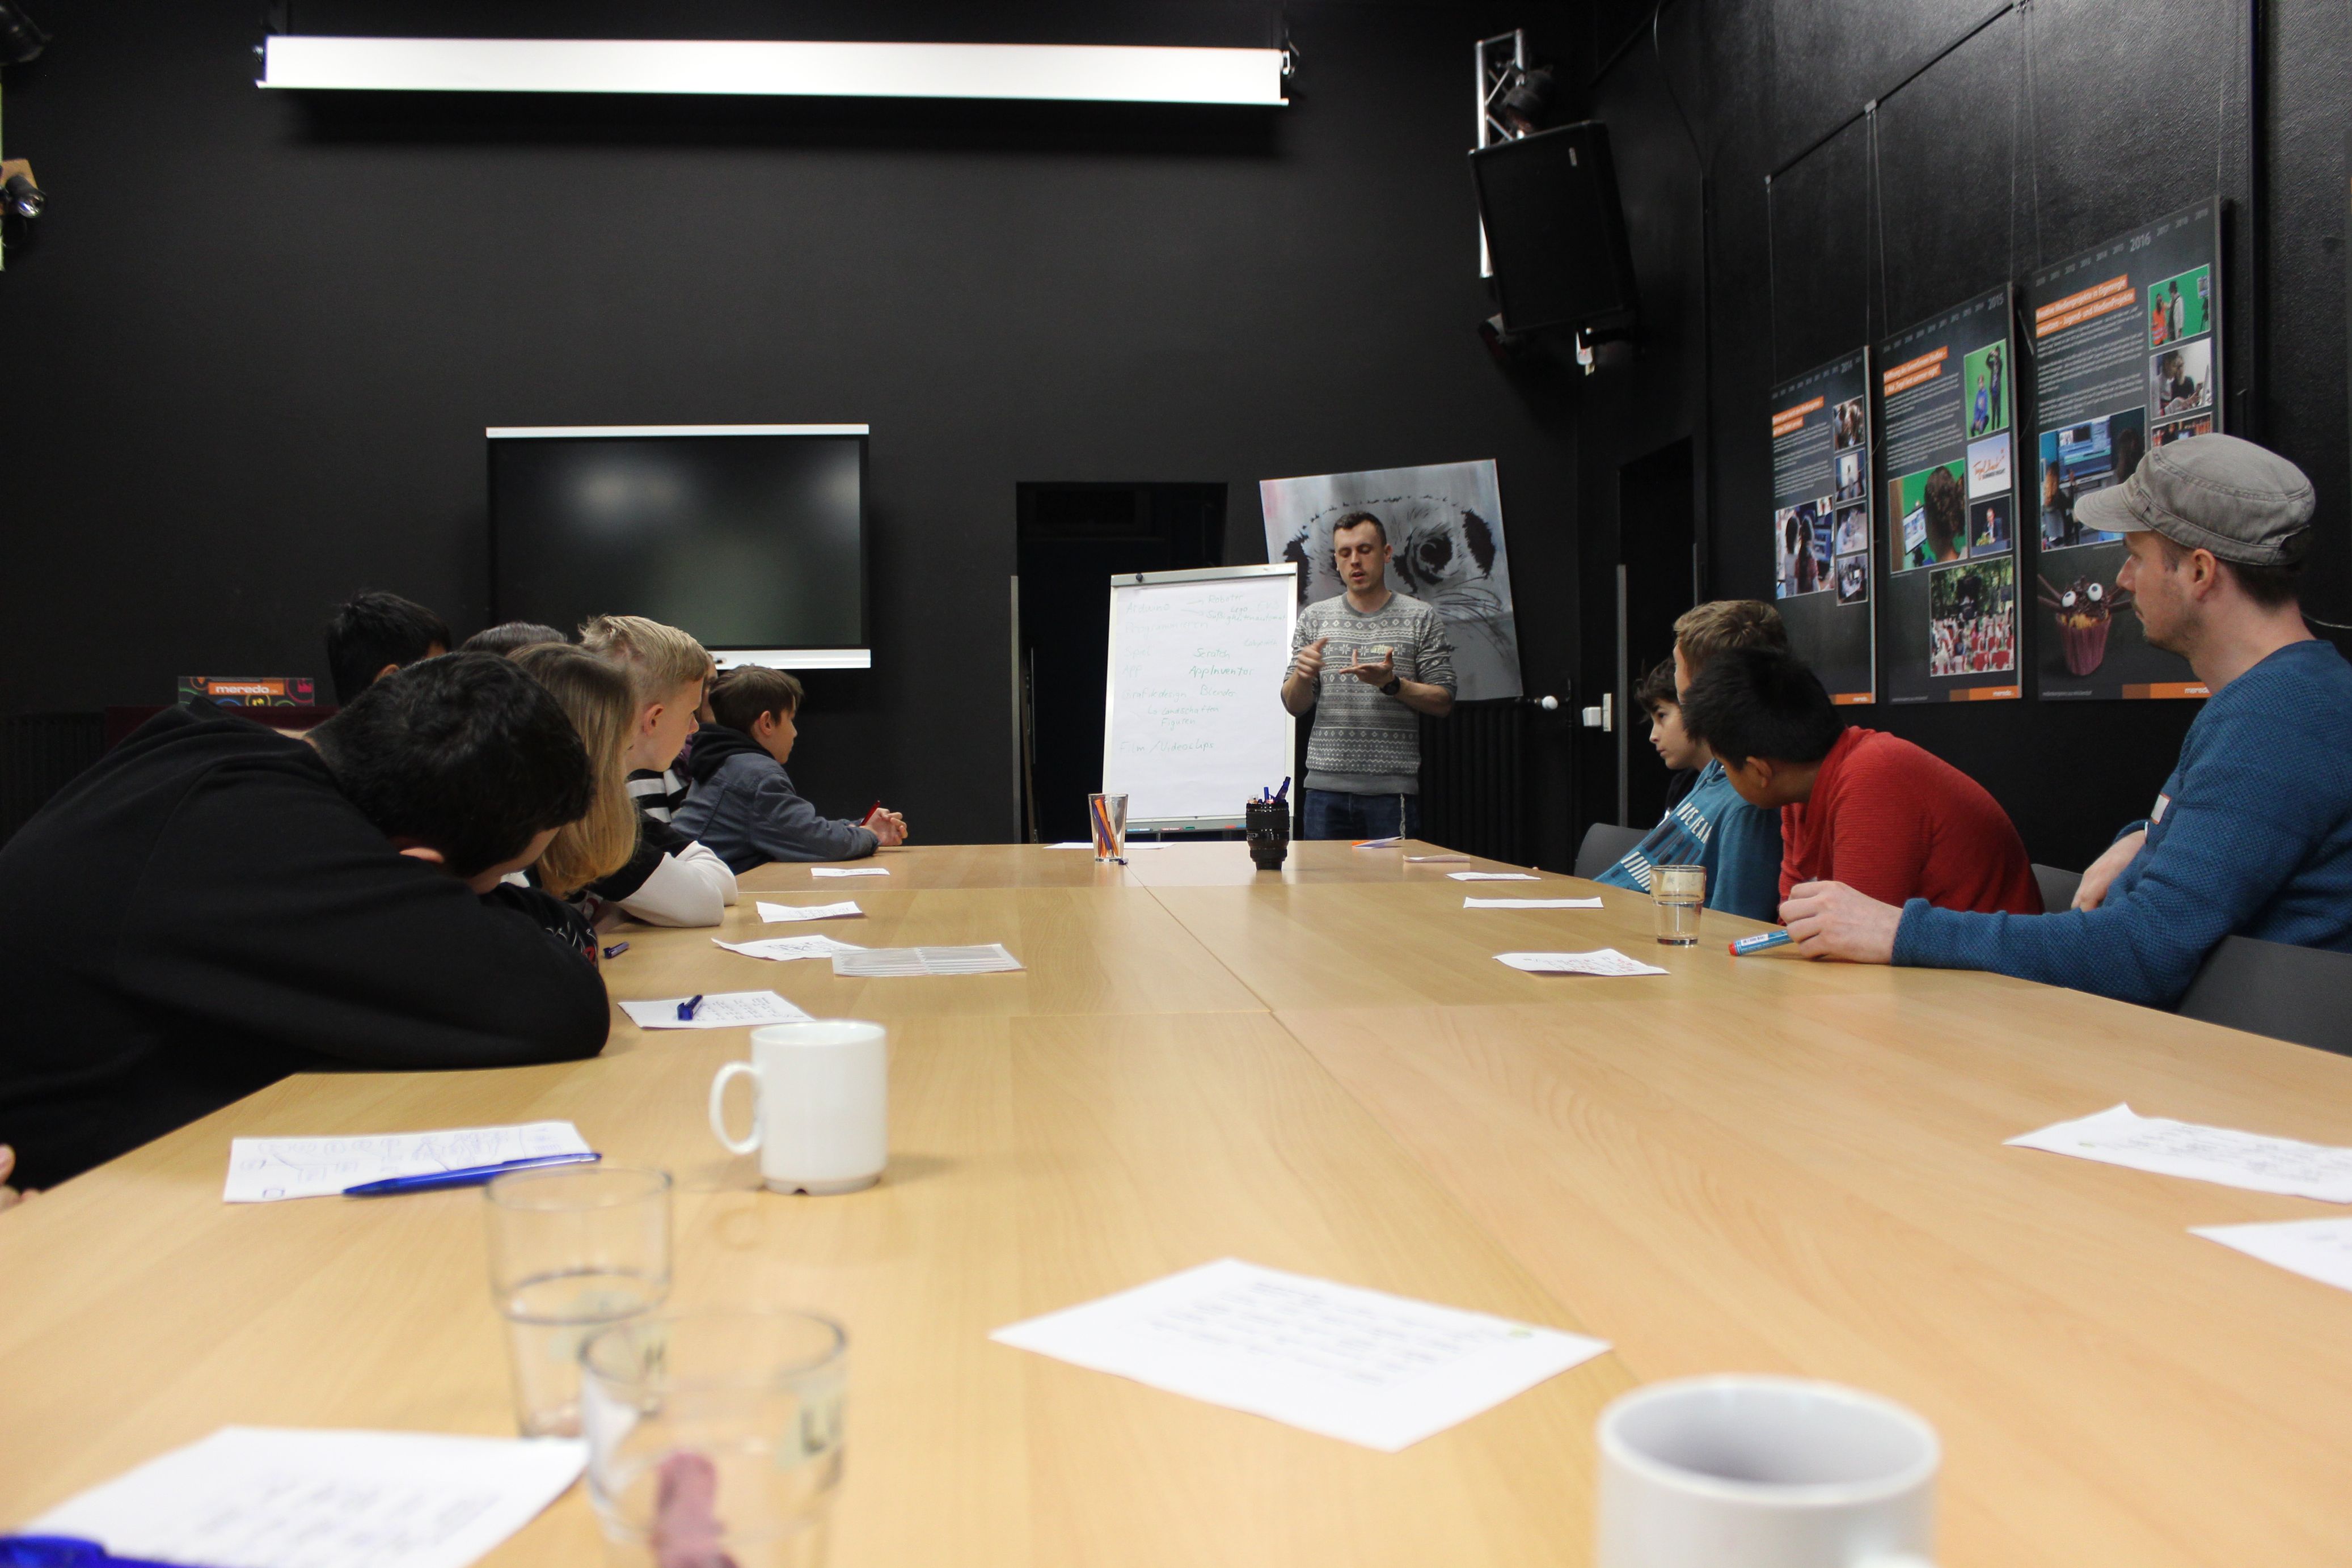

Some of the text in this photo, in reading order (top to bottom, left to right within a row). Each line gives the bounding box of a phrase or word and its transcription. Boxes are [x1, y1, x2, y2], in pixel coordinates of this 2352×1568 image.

[2130, 231, 2151, 252] 2016
[1208, 594, 1244, 604] Roboter
[1126, 602, 1171, 614] Arduino
[1193, 648, 1230, 660] Scratch
[1200, 684, 1237, 696] Blender
[1161, 717, 1196, 731] Figuren
